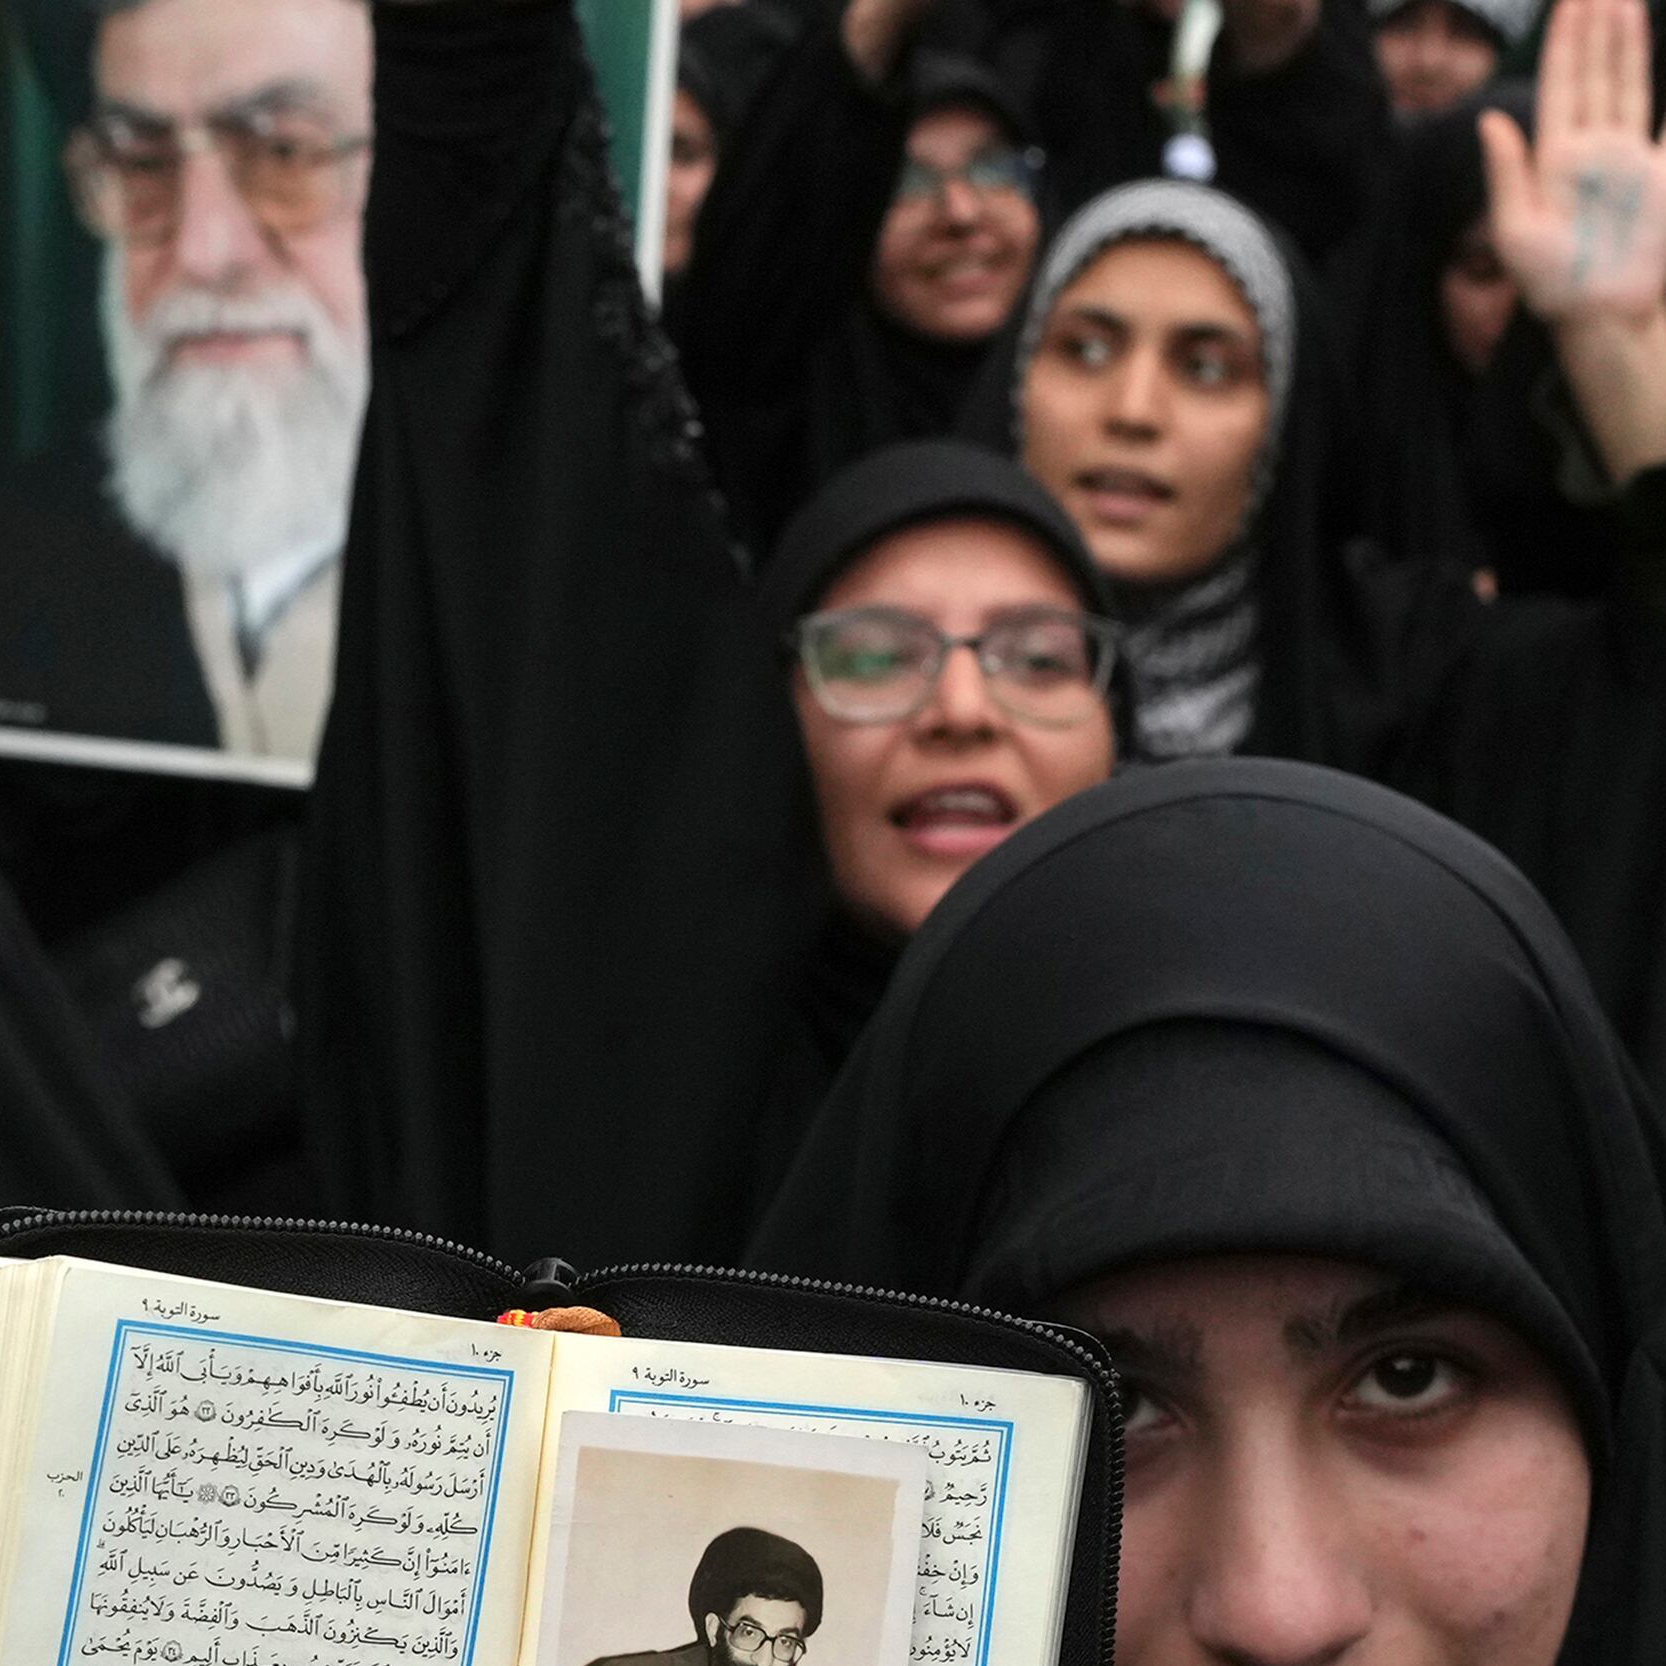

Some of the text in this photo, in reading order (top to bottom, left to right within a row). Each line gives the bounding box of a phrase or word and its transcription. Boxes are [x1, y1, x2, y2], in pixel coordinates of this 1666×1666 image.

[153, 1299, 188, 1319] التوبة
[190, 1305, 221, 1324] سورة
[644, 1367, 677, 1386] التوبة
[679, 1371, 710, 1389] سورة
[974, 1400, 996, 1412] جزء
[46, 1470, 83, 1484] الحزب
